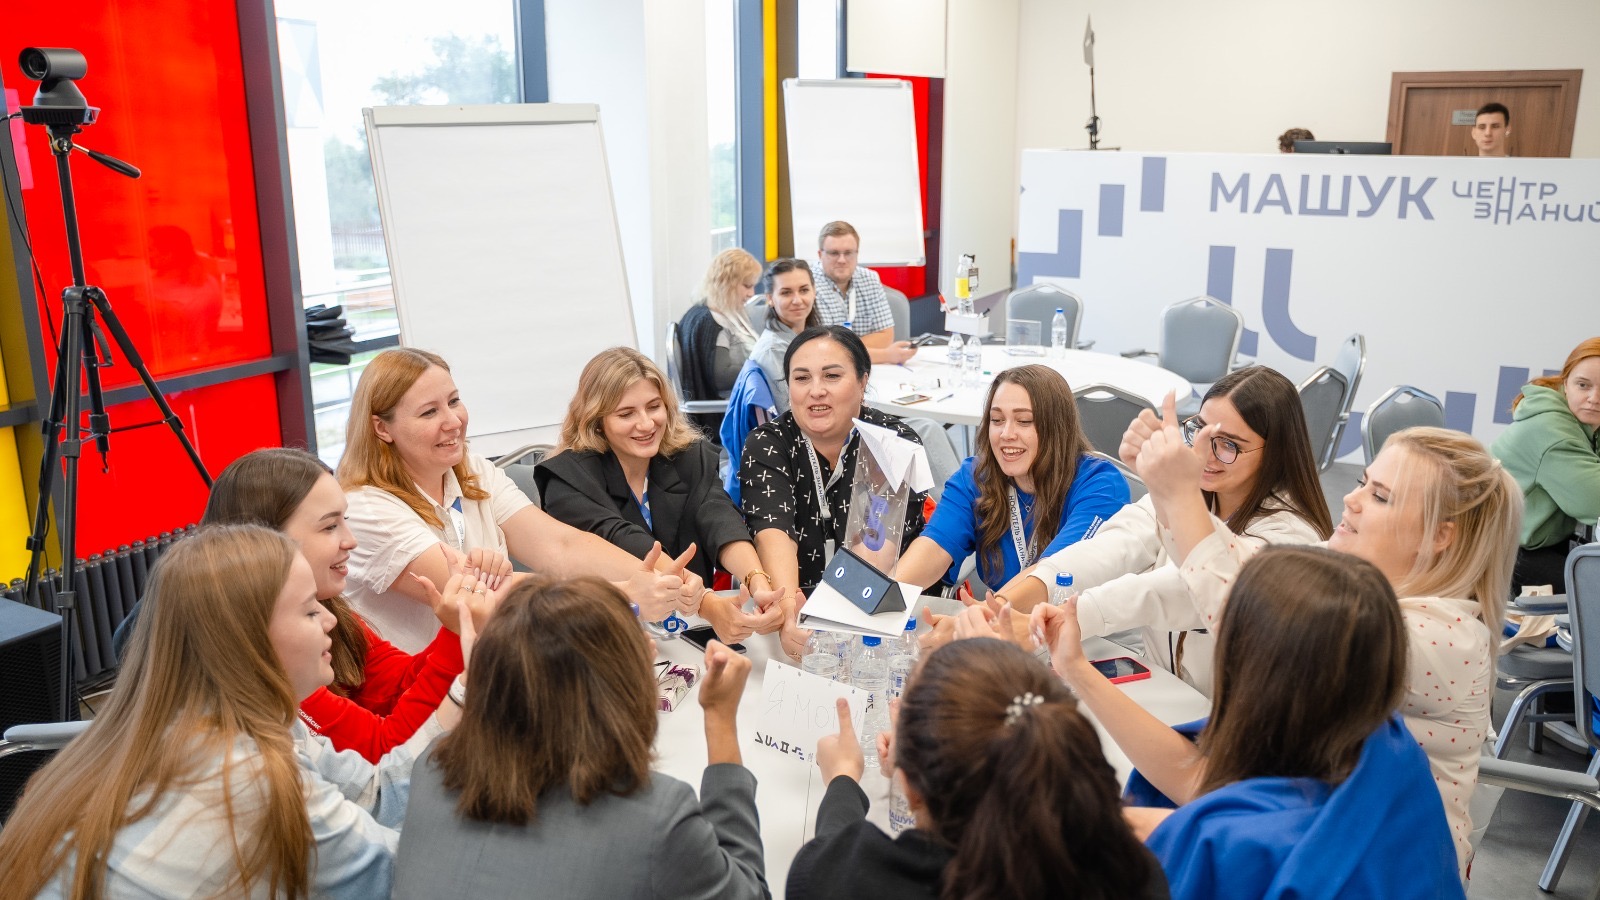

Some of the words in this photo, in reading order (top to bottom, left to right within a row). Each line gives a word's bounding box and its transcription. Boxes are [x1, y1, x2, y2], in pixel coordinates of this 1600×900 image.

[1210, 172, 1438, 220] МАШУК
[1452, 176, 1558, 201] ЦЕНТР
[1008, 495, 1021, 535] НОСИТЕЛЬ
[1015, 537, 1026, 563] ЗНАНИ
